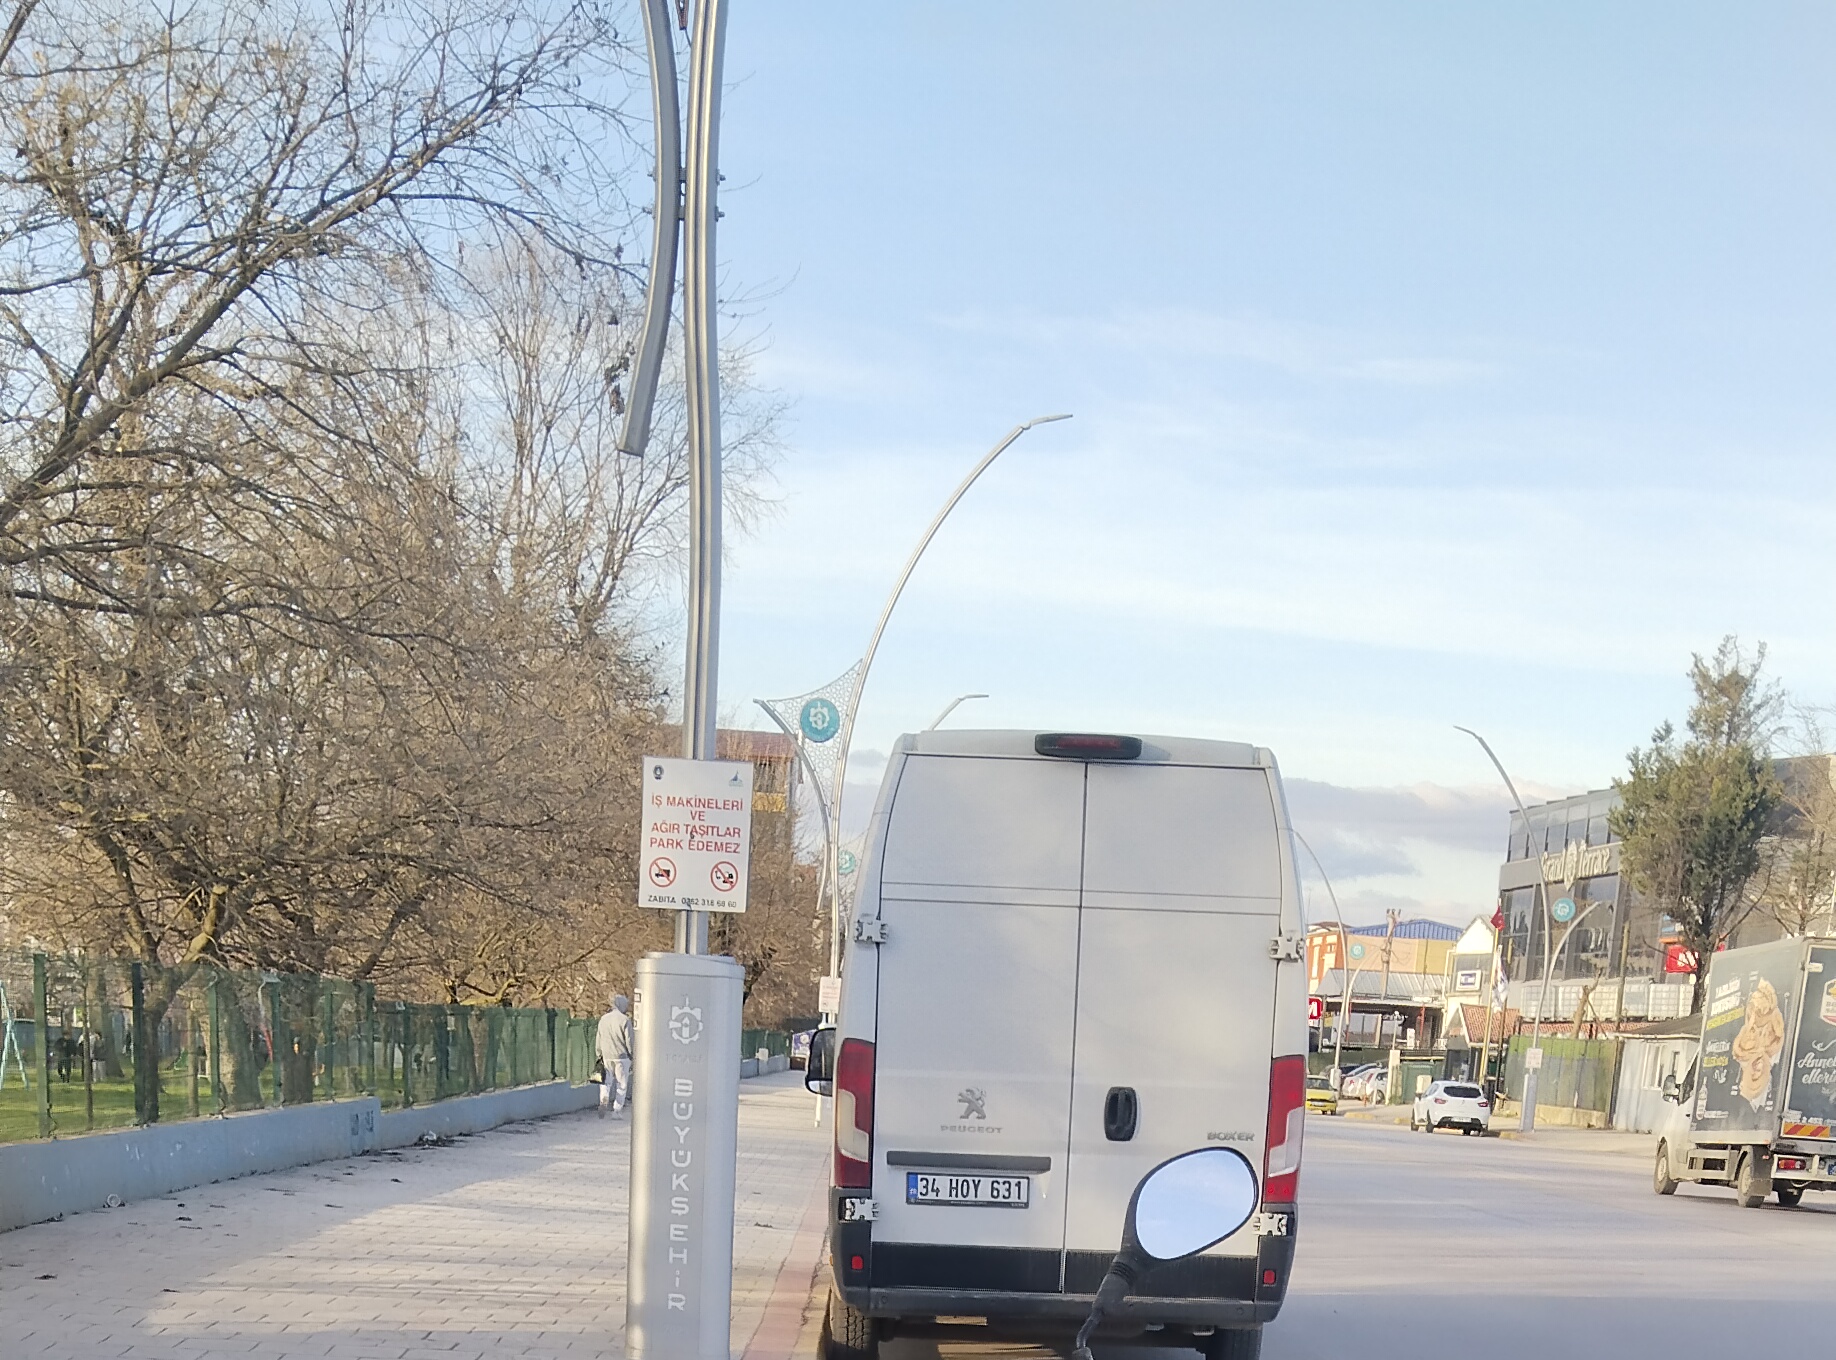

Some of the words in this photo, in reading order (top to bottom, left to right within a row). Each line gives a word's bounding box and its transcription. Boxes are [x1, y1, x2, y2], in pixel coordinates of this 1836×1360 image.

[651, 793, 662, 808] İŞ
[666, 794, 743, 811] MAKİNELERİ
[690, 810, 706, 821] VE
[651, 820, 681, 834] AĞIR
[683, 823, 741, 838] TAŞITLAR
[650, 837, 683, 850] PARK
[688, 839, 741, 854] EDEMEZ
[940, 1125, 1002, 1134] PEUGEOT
[1207, 1131, 1255, 1141] BOXER
[919, 1177, 940, 1197] 34
[949, 1178, 981, 1199] HOY
[990, 1180, 1022, 1200] 631
